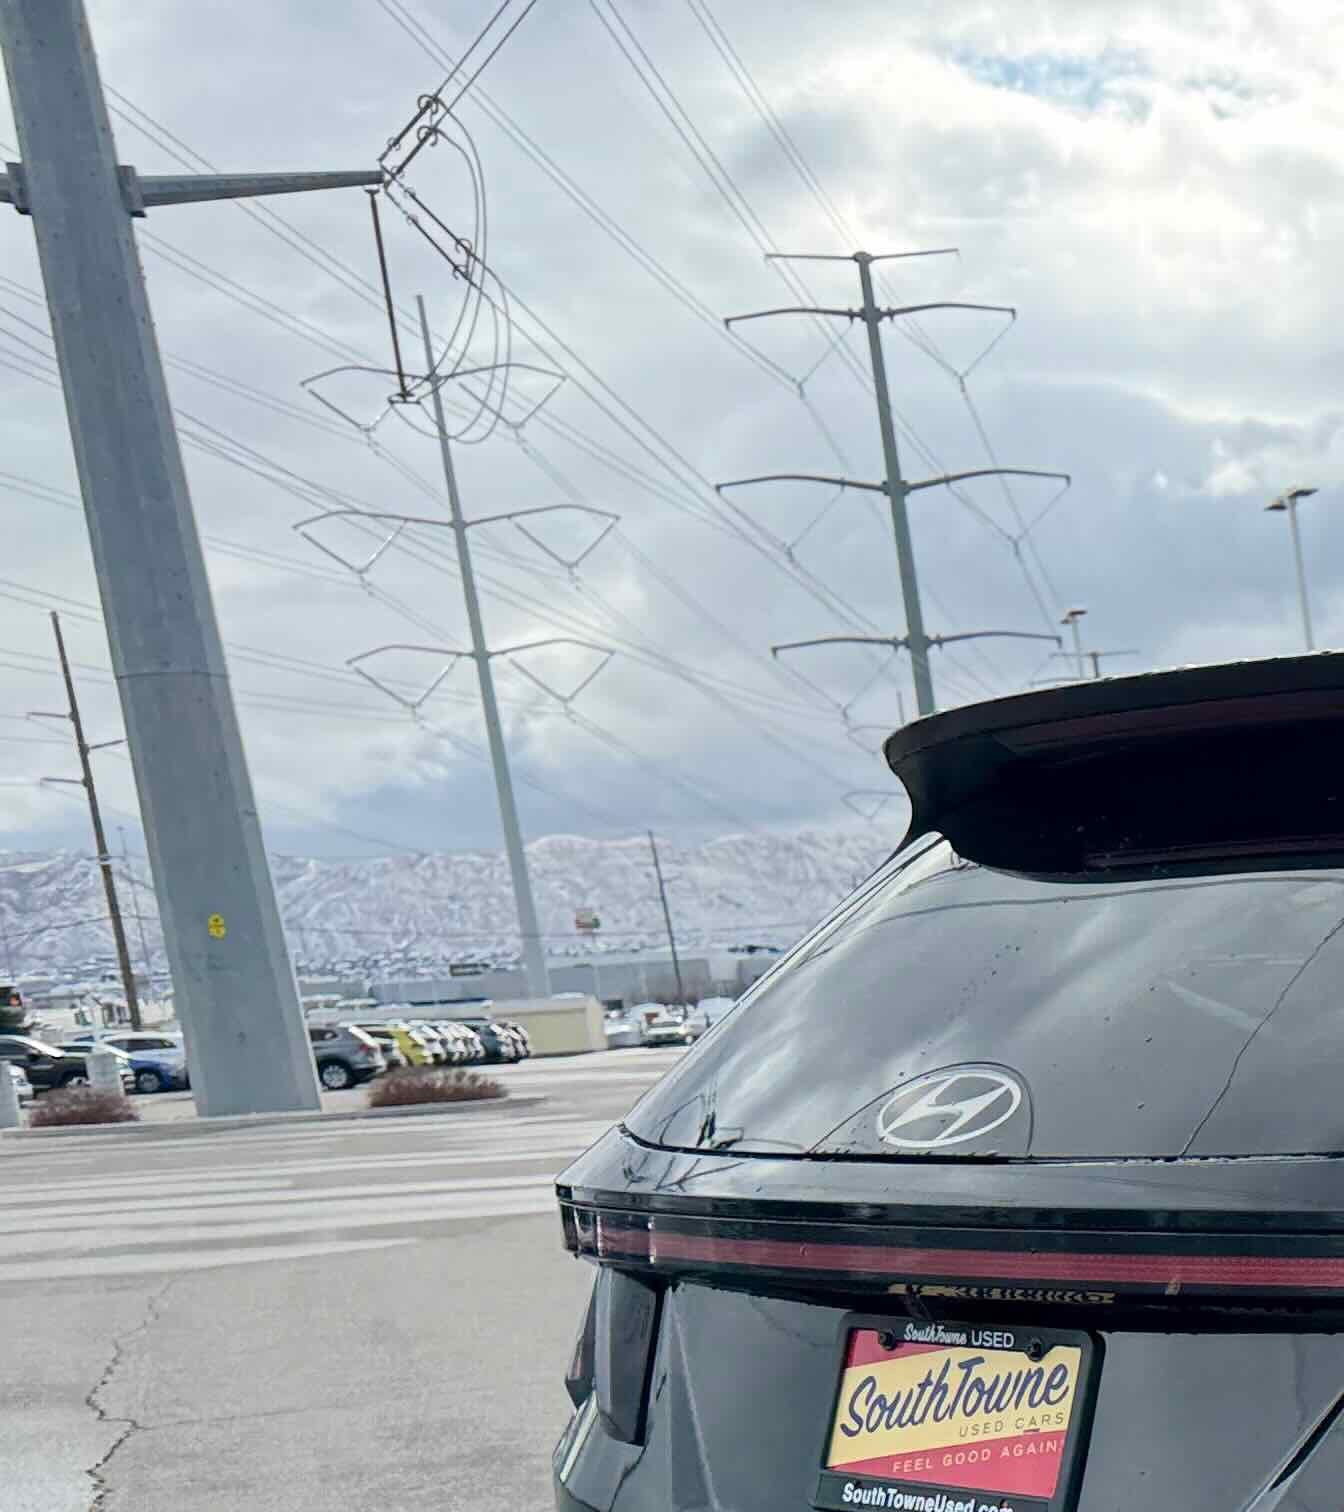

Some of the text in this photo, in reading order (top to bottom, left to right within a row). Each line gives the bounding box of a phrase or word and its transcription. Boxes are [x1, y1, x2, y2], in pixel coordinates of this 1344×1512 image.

[904, 1323, 1015, 1348] SouthTowne USED
[840, 1356, 1070, 1437] SouthTowne
[959, 1412, 1064, 1438] USED CARS
[892, 1458, 934, 1473] FEEL
[942, 1448, 992, 1466] GOOD
